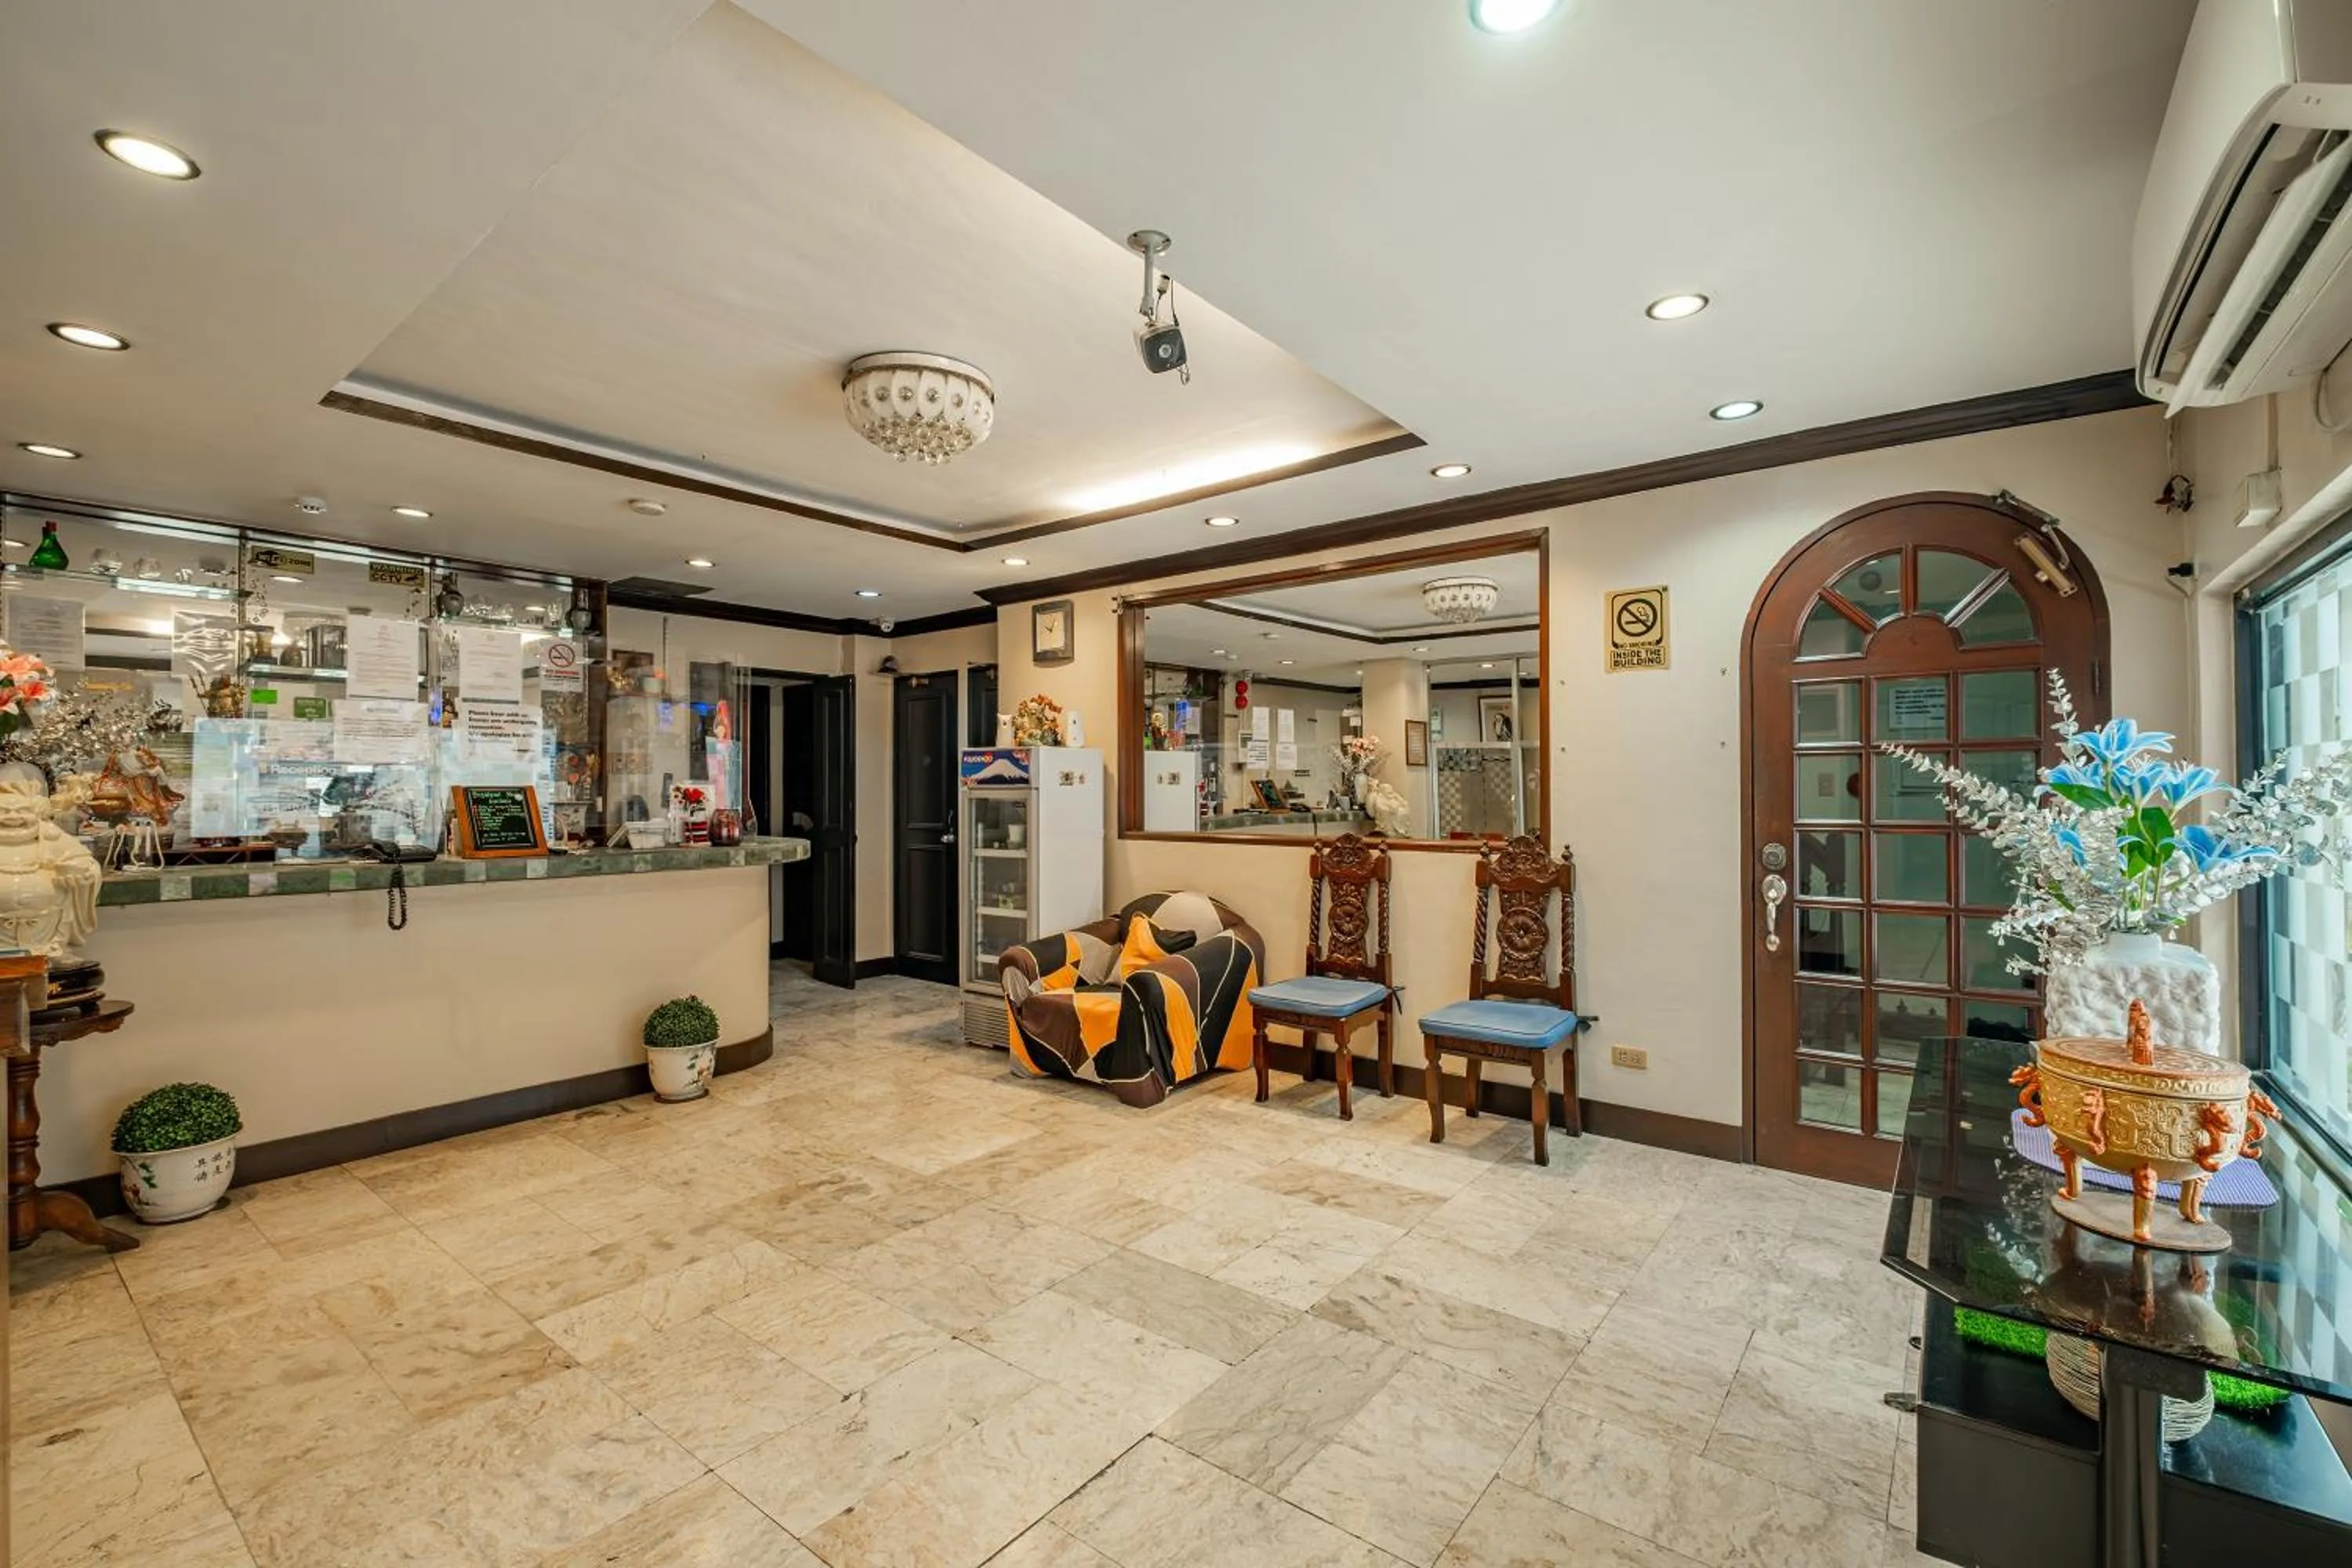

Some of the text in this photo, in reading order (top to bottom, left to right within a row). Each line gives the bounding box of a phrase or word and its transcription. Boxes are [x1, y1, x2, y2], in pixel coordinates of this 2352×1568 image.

[372, 564, 423, 575] WARNING
[372, 572, 402, 583] CCTV
[1613, 650, 1642, 659] INSIDE
[1613, 657, 1661, 666] BUILDING
